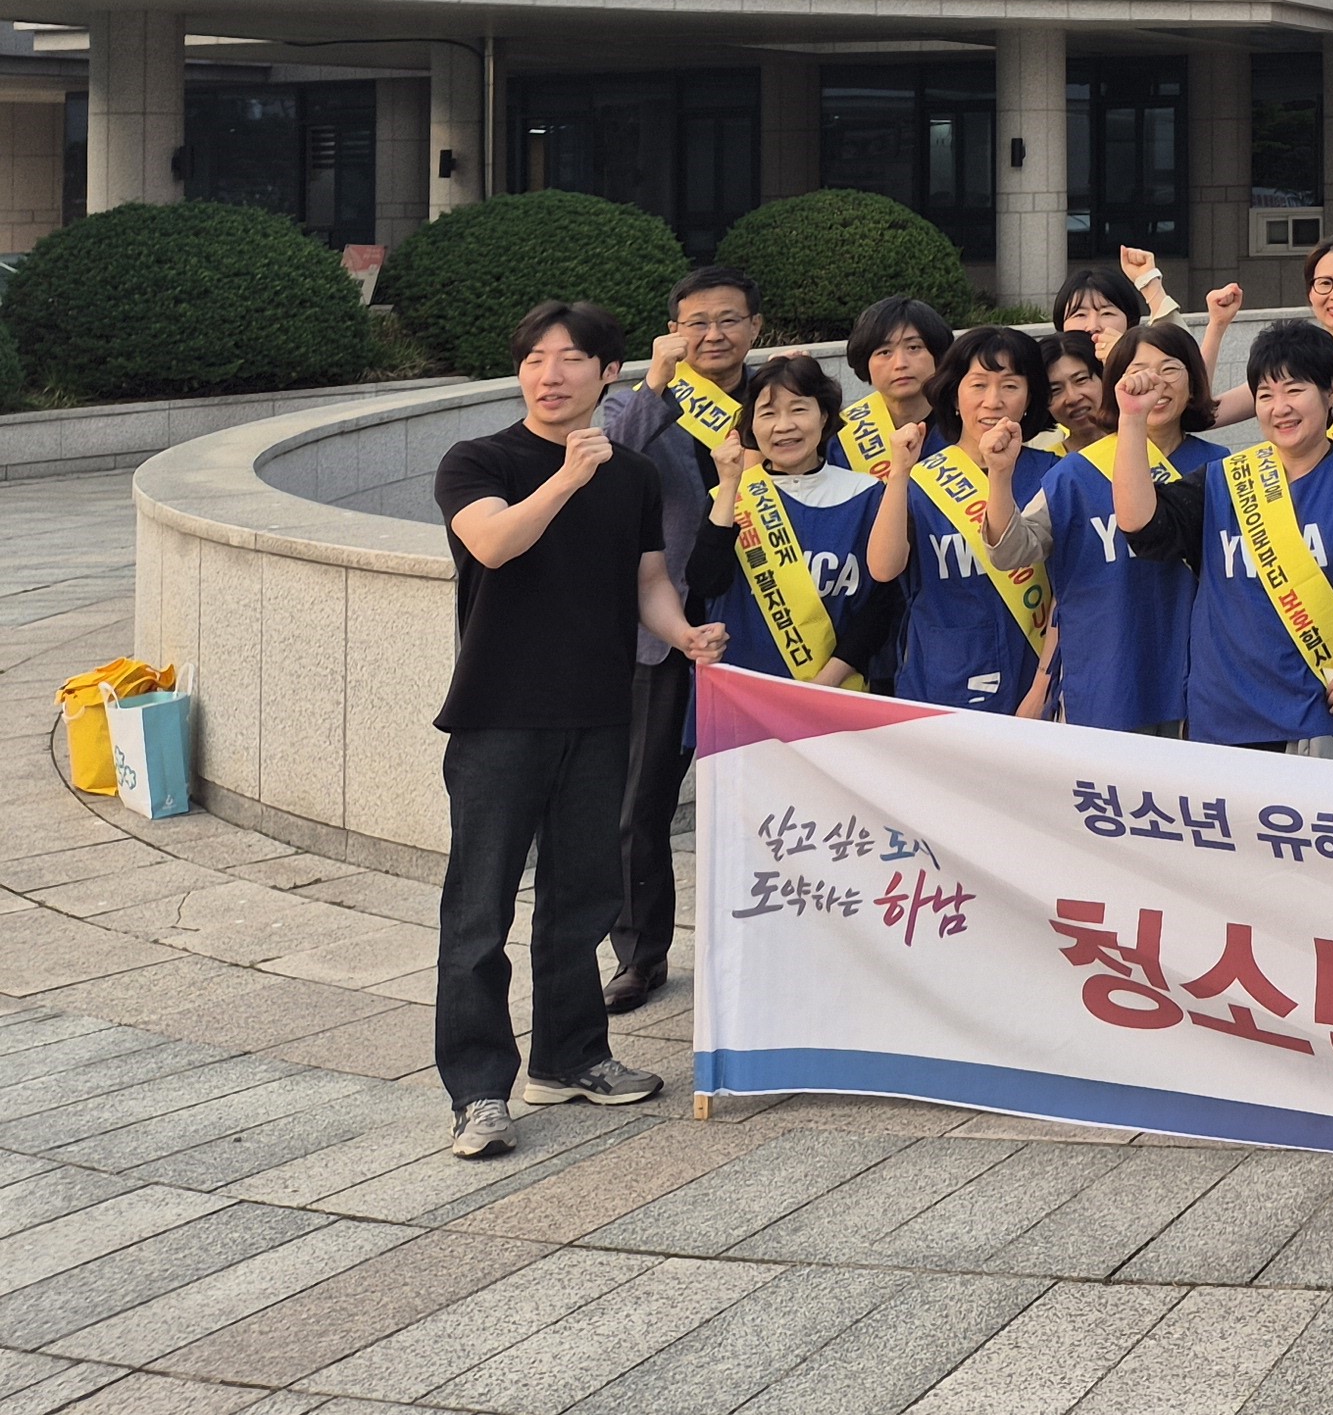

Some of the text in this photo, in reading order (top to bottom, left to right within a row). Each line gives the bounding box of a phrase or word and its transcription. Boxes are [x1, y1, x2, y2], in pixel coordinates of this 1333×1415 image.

[846, 402, 887, 461] 청소년
[748, 480, 799, 568] 청소년에게
[921, 452, 978, 503] 청소년
[1022, 584, 1049, 637] OU
[753, 569, 814, 668] 팔지맙시다
[1277, 587, 1333, 678] 보호합시
[879, 825, 941, 871] 도시
[1071, 780, 1237, 852] 청소년
[731, 868, 977, 947] 도약하는 하남
